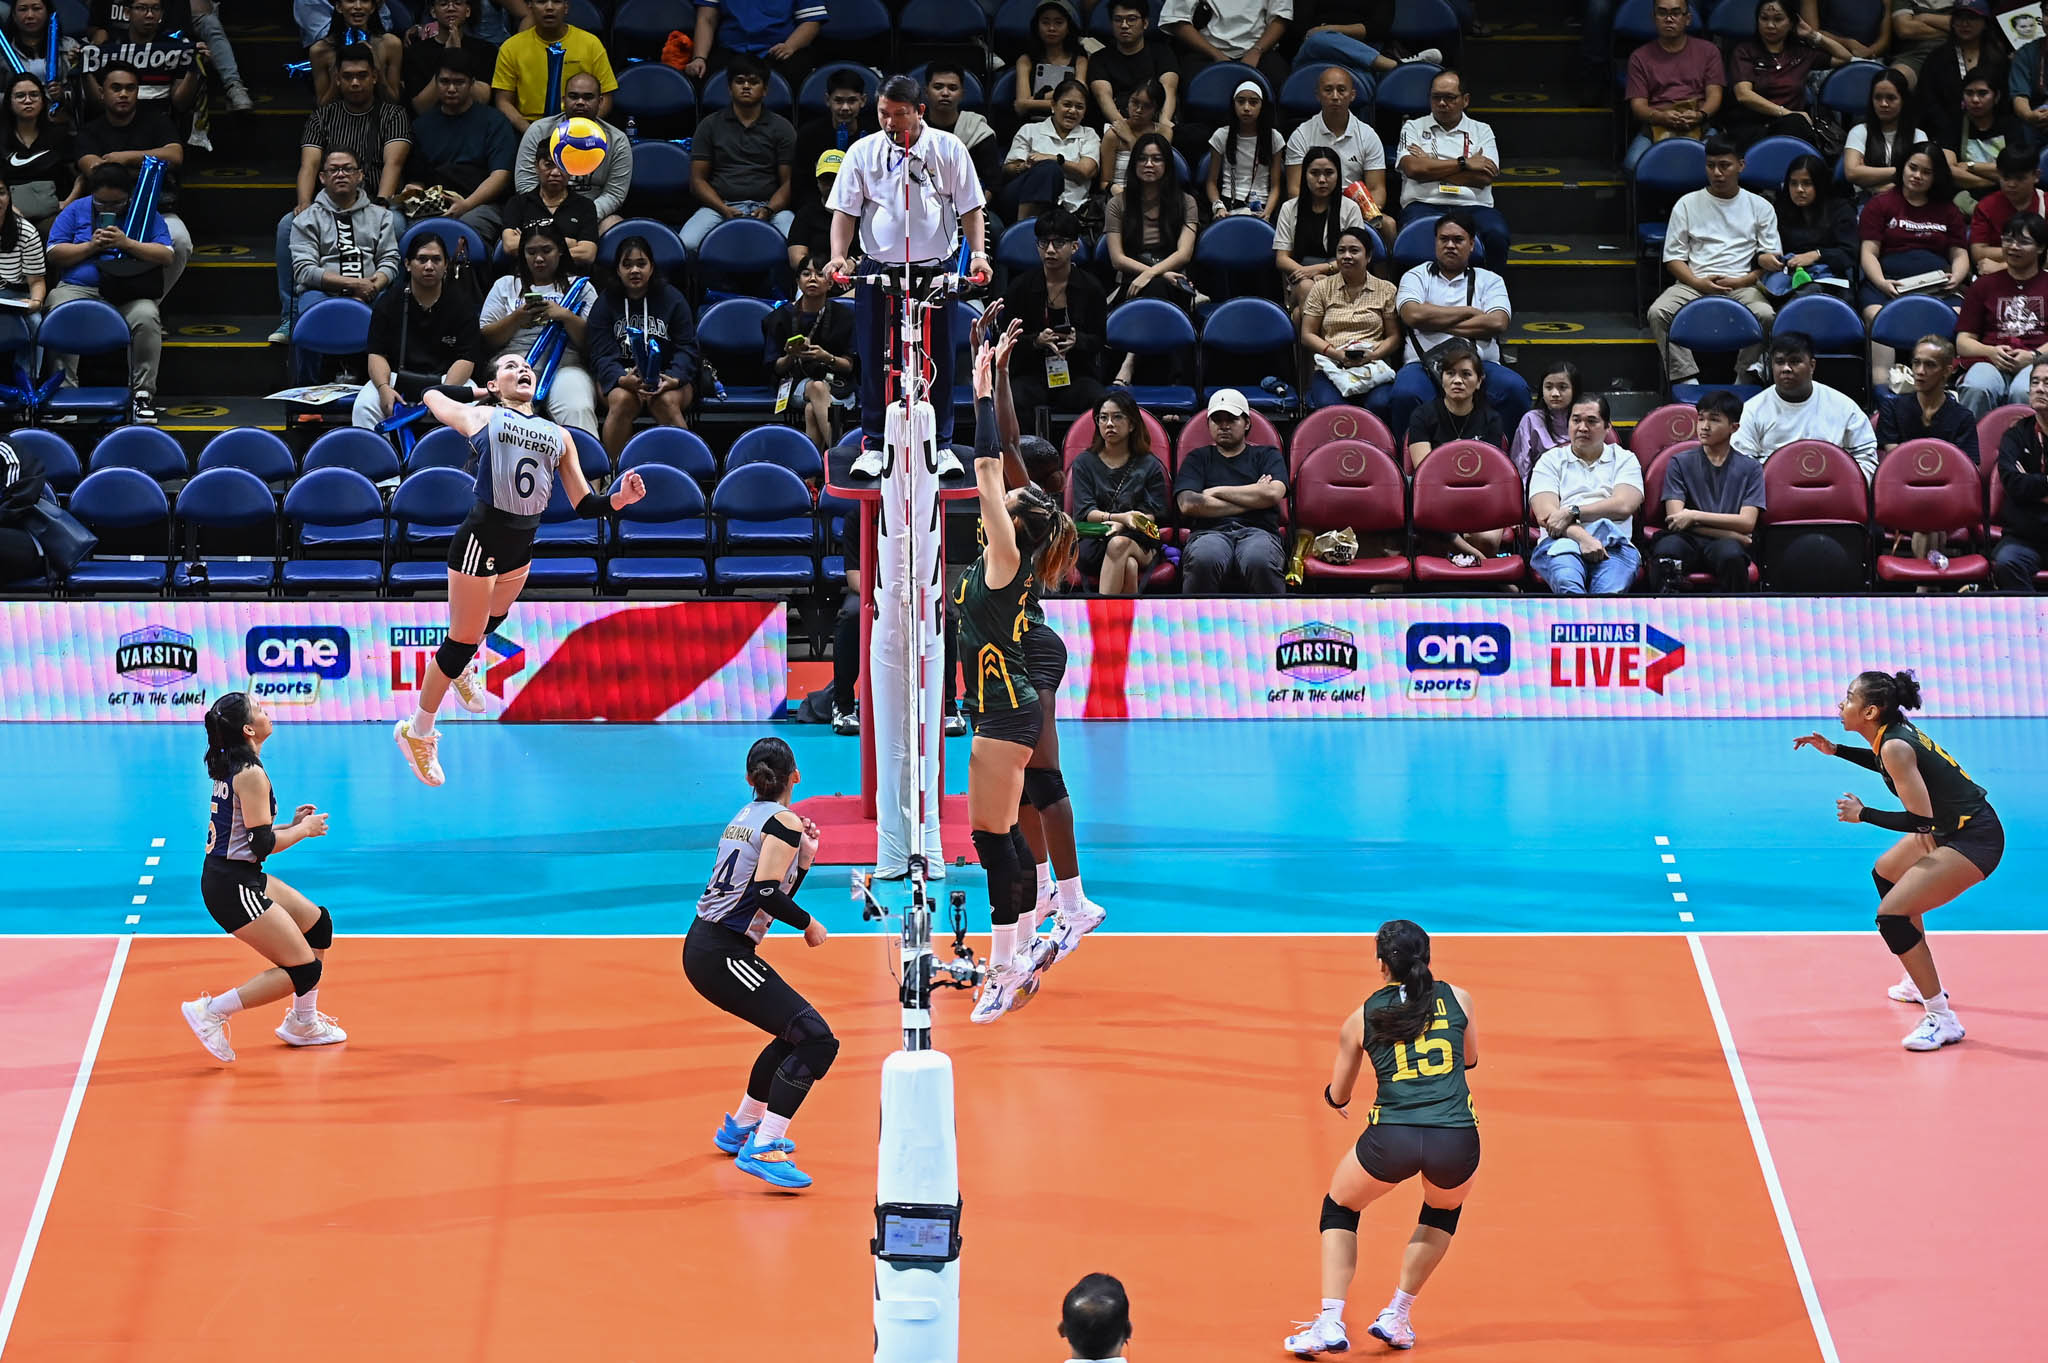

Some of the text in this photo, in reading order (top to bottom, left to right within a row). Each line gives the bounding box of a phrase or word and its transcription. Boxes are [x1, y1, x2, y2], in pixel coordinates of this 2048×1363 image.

[498, 432, 562, 461] UNIVERSITY
[503, 422, 559, 448] NATIONAL
[514, 458, 539, 499] 6
[1554, 625, 1635, 642] PILIPINAS
[121, 645, 193, 668] VARSITY
[258, 638, 339, 667] one
[1280, 642, 1353, 665] VARSITY
[1418, 634, 1499, 664] one
[1551, 647, 1640, 687] LIVE
[108, 687, 206, 706] GET IN THE GAME!
[254, 680, 313, 698] sports
[1268, 685, 1366, 703] GET IN THE GAME!
[1414, 677, 1472, 694] sports
[1391, 1018, 1454, 1082] 15
